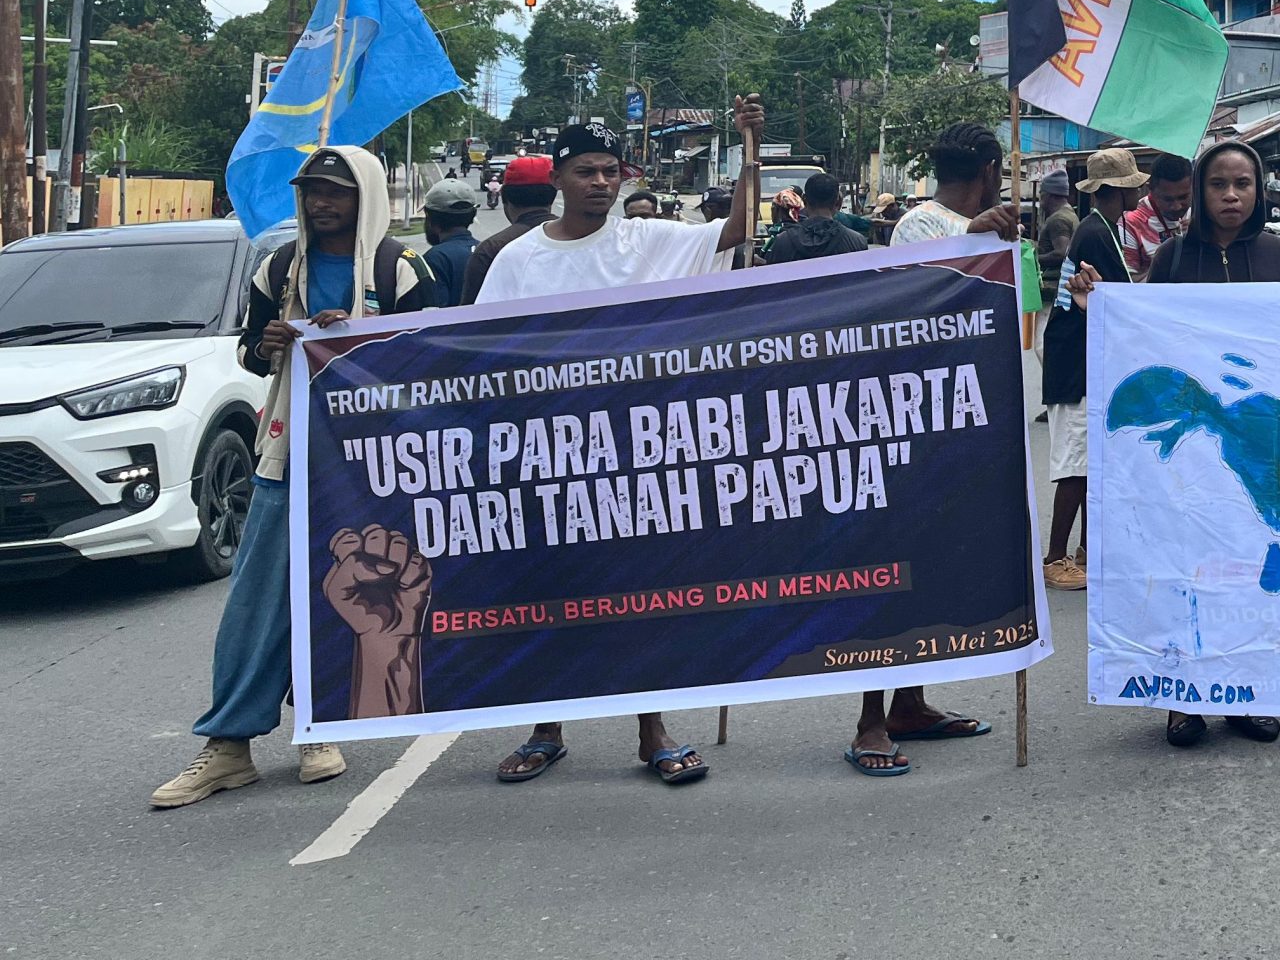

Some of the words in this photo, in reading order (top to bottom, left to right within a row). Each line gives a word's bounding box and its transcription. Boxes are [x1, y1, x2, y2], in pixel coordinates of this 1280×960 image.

[326, 384, 405, 415] FRONT
[410, 371, 507, 407] RAKYAT
[513, 355, 643, 394] DOMBERAI
[650, 343, 734, 377] TOLAK
[740, 335, 793, 366] PSN
[800, 333, 818, 359] &
[825, 309, 996, 356] MILITERISME
[343, 428, 475, 498] "USIR
[488, 410, 619, 485] PARA
[629, 394, 748, 469] BABI
[762, 363, 989, 453] JAKARTA
[413, 487, 527, 559] DARI
[535, 468, 703, 546] TANAH
[714, 441, 911, 527] PAPUA"
[432, 604, 554, 633] BERSATU,
[564, 587, 704, 621] BERJUANG
[716, 580, 768, 604] DAN
[778, 562, 901, 597] MENANG!
[916, 638, 938, 656] 21
[946, 631, 985, 653] Mei
[993, 620, 1034, 647] 2025
